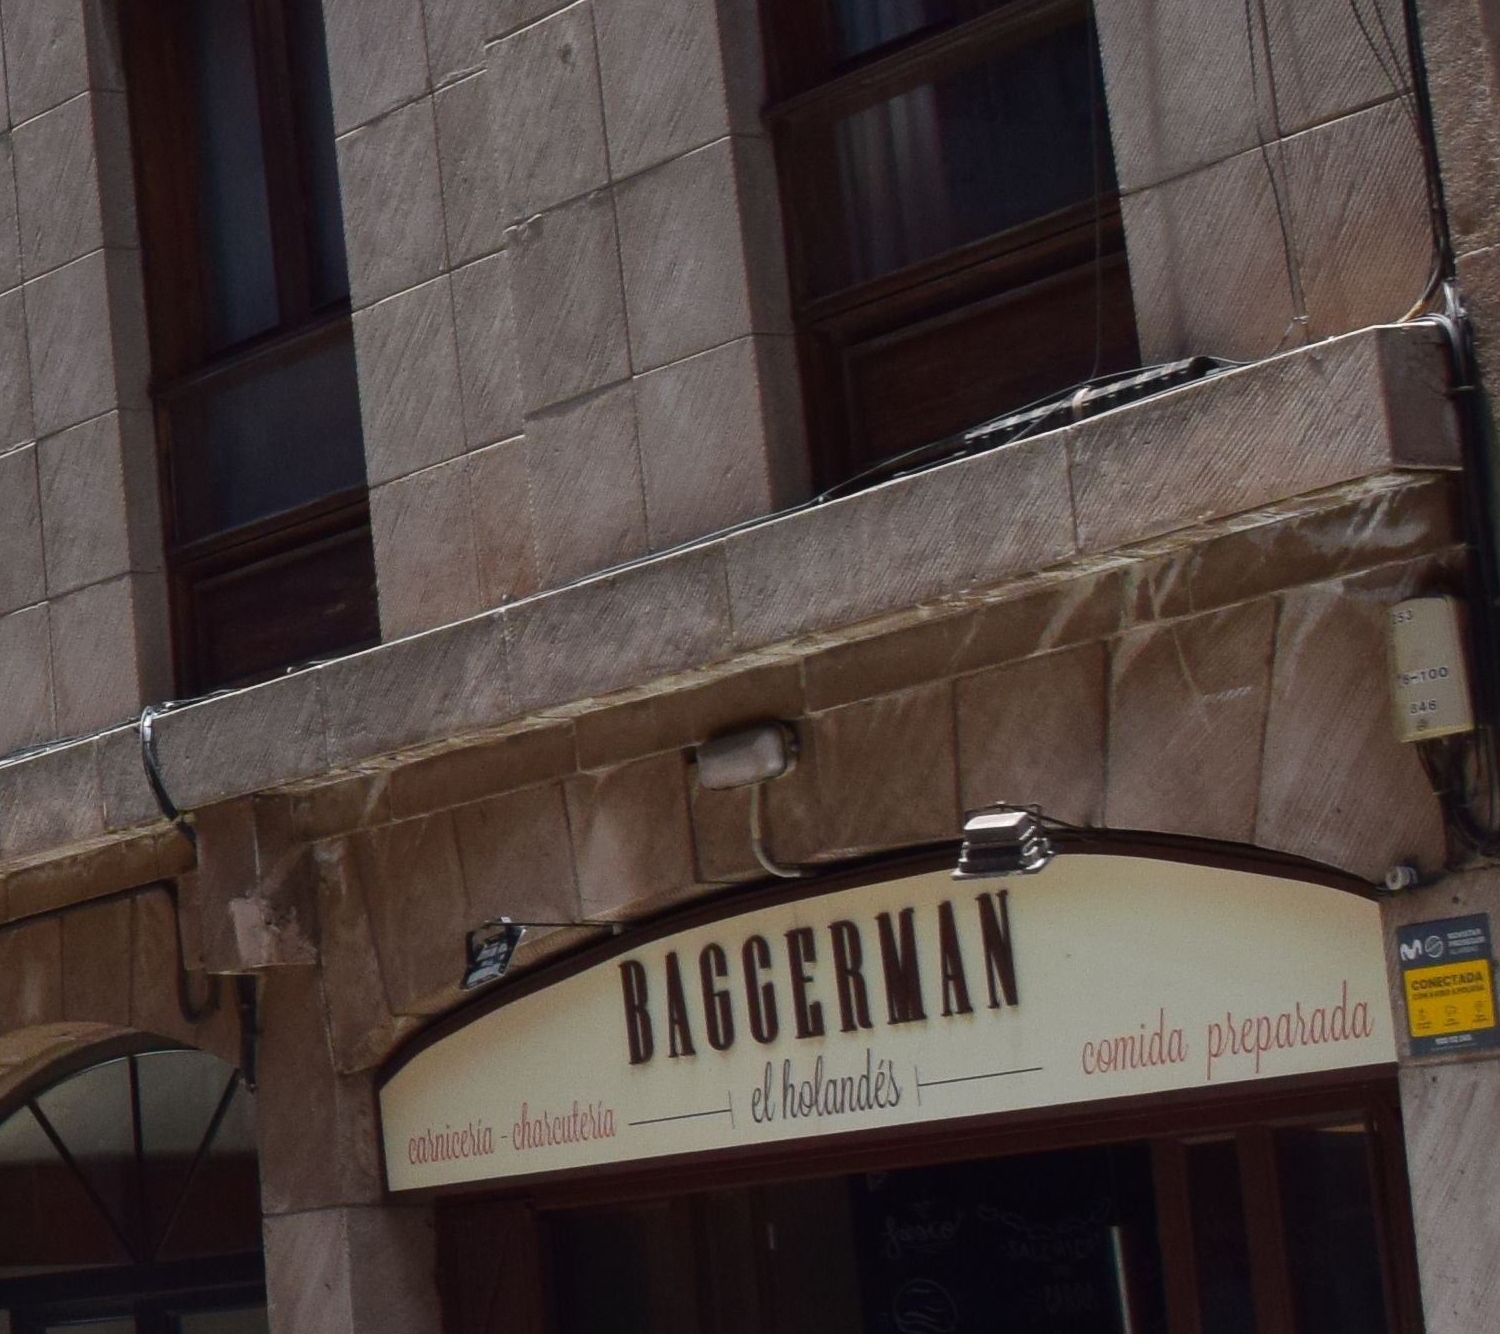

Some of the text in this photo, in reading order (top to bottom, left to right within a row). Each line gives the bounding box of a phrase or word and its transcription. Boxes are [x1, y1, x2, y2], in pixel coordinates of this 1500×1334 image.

[619, 889, 1018, 1065] BAGGERMAN
[1411, 971, 1483, 991] CONECTADA
[1082, 979, 1374, 1080] comida preparada
[751, 1049, 902, 1123] el holandés
[407, 1119, 496, 1165] carnicería
[512, 1100, 617, 1151] charcutería
